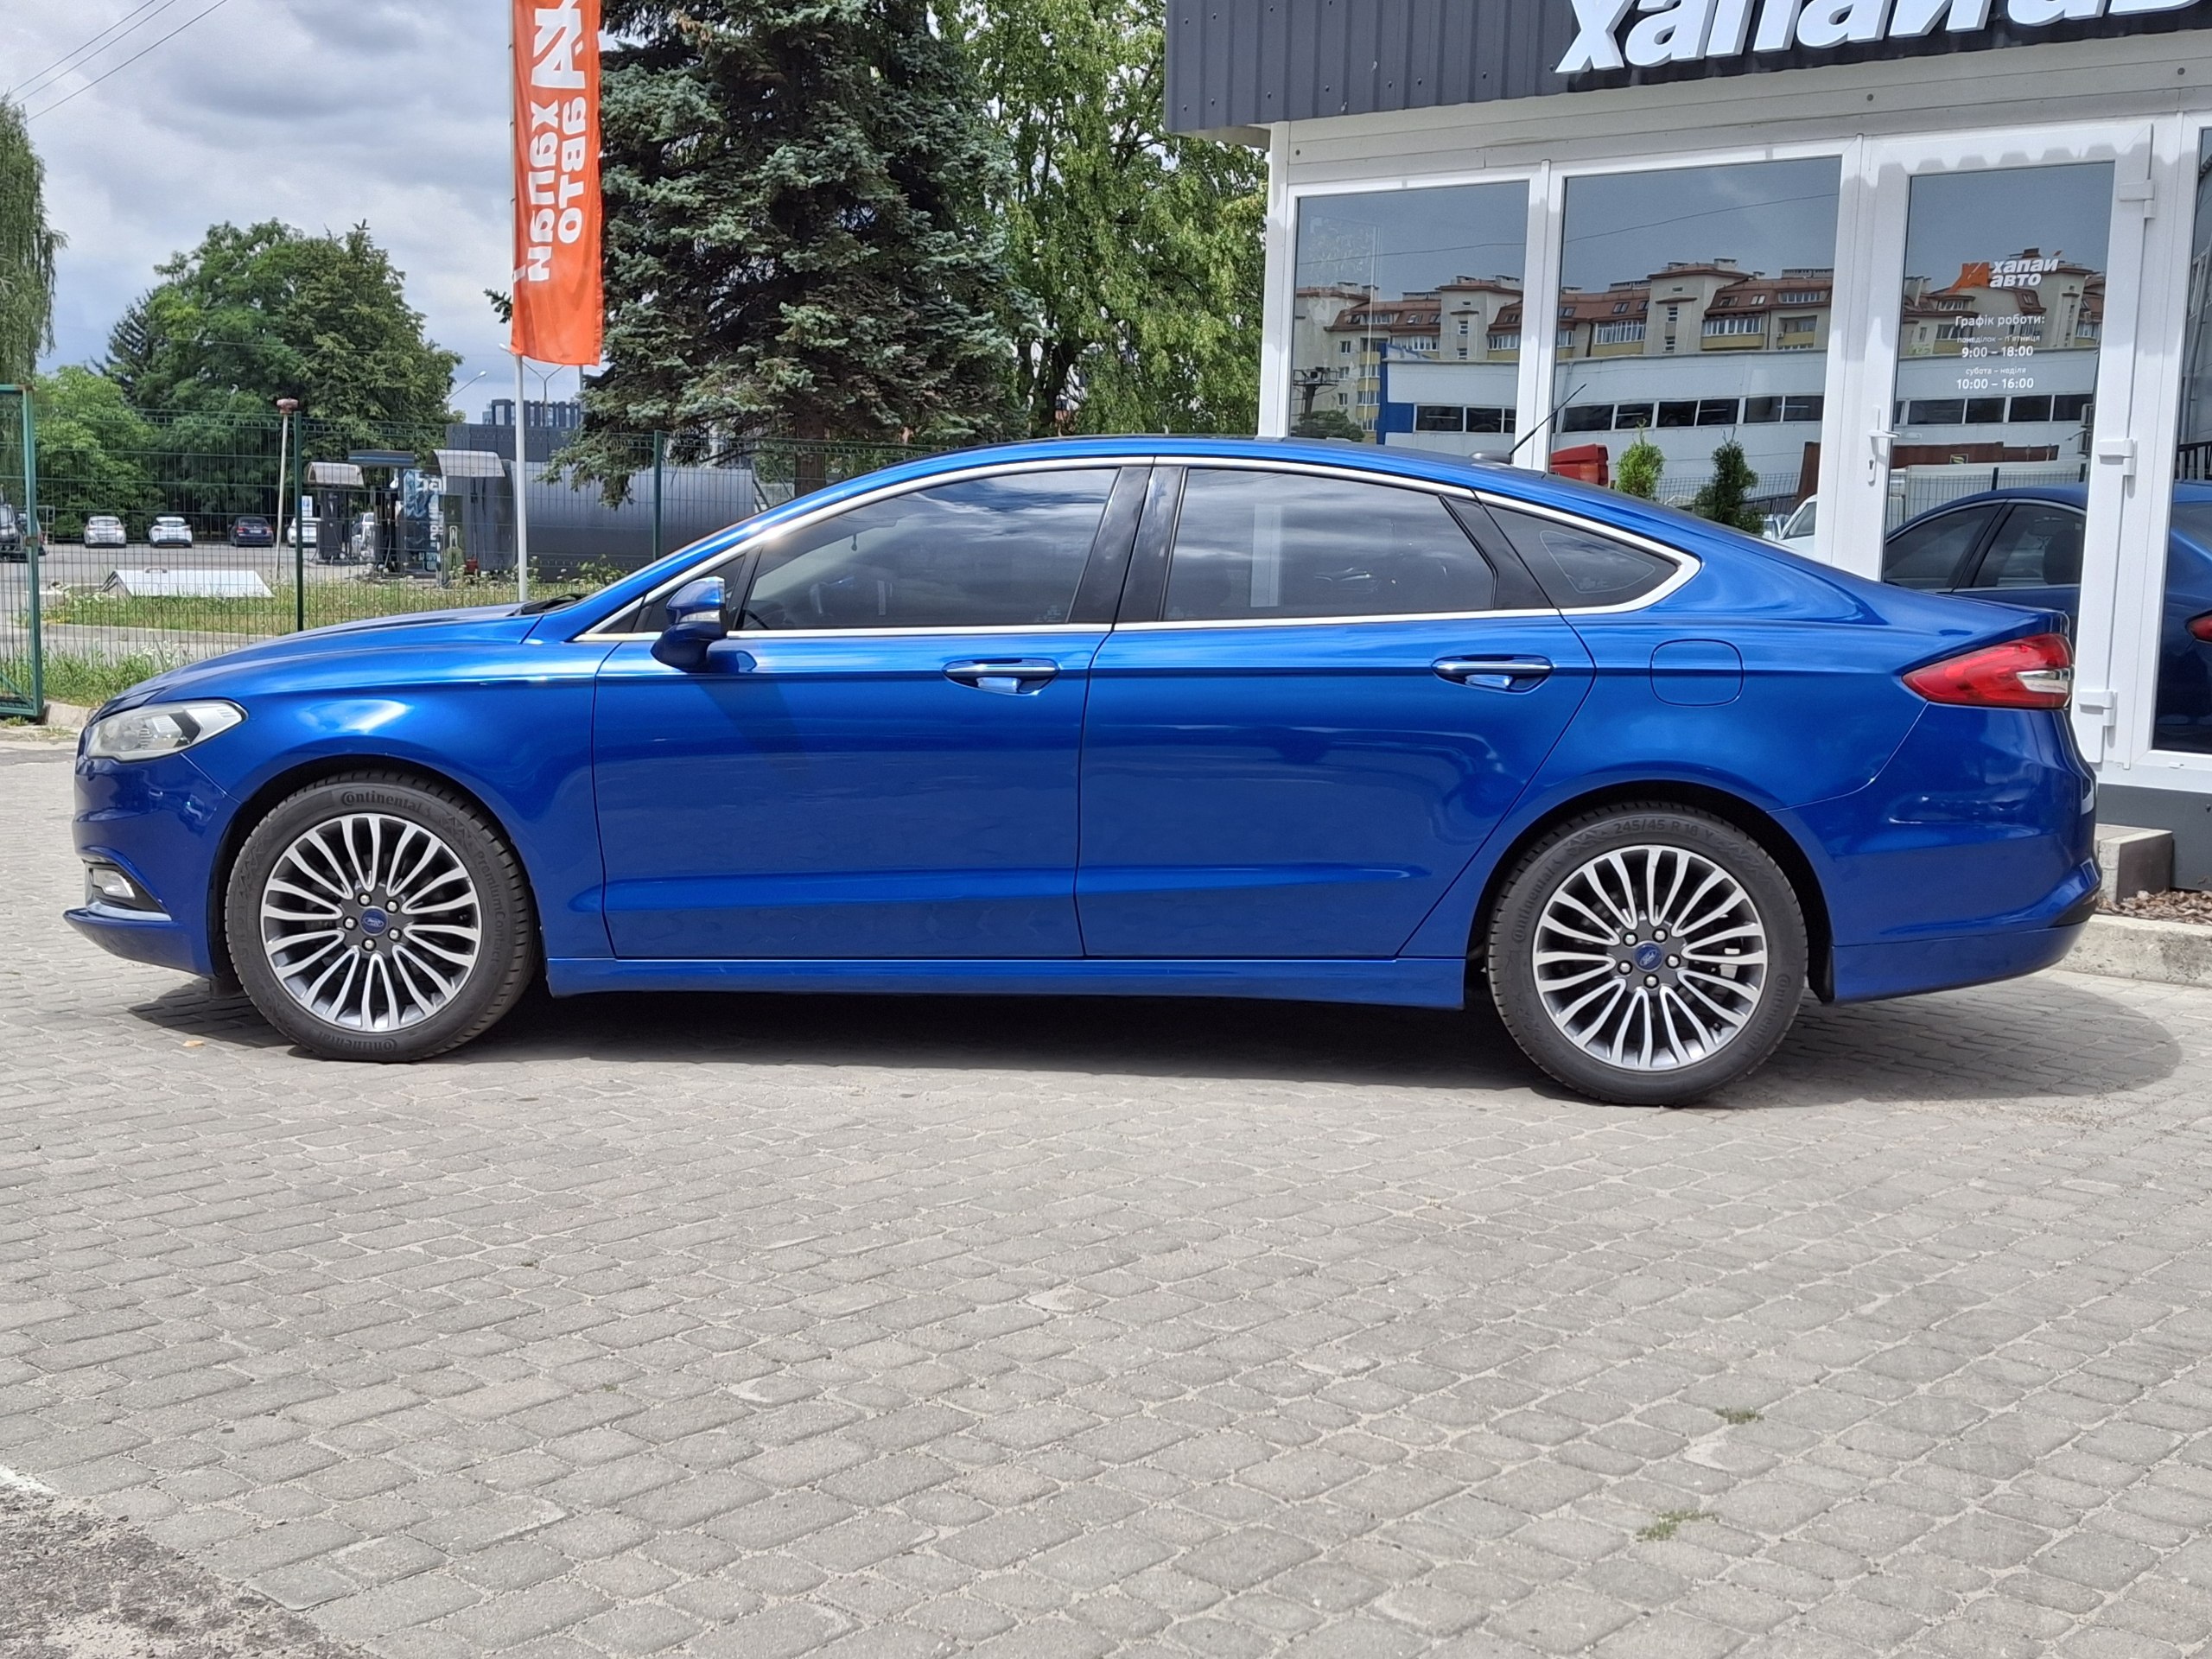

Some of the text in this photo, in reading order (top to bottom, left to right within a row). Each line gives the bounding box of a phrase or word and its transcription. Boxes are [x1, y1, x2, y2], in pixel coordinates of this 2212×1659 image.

[1991, 251, 2062, 274] хапай
[1989, 273, 2042, 288] авто
[1955, 314, 2045, 327] Графік роботи:
[1961, 346, 1987, 358] 9:00
[2001, 346, 2034, 357] 18:00
[1965, 367, 1992, 376] субота
[2000, 366, 2026, 375] неділя
[1956, 378, 1988, 390] 10:00
[2002, 378, 2034, 389] 16:00
[340, 790, 423, 813] Continental
[1614, 819, 1666, 835] 245/45
[1671, 821, 1681, 831] R
